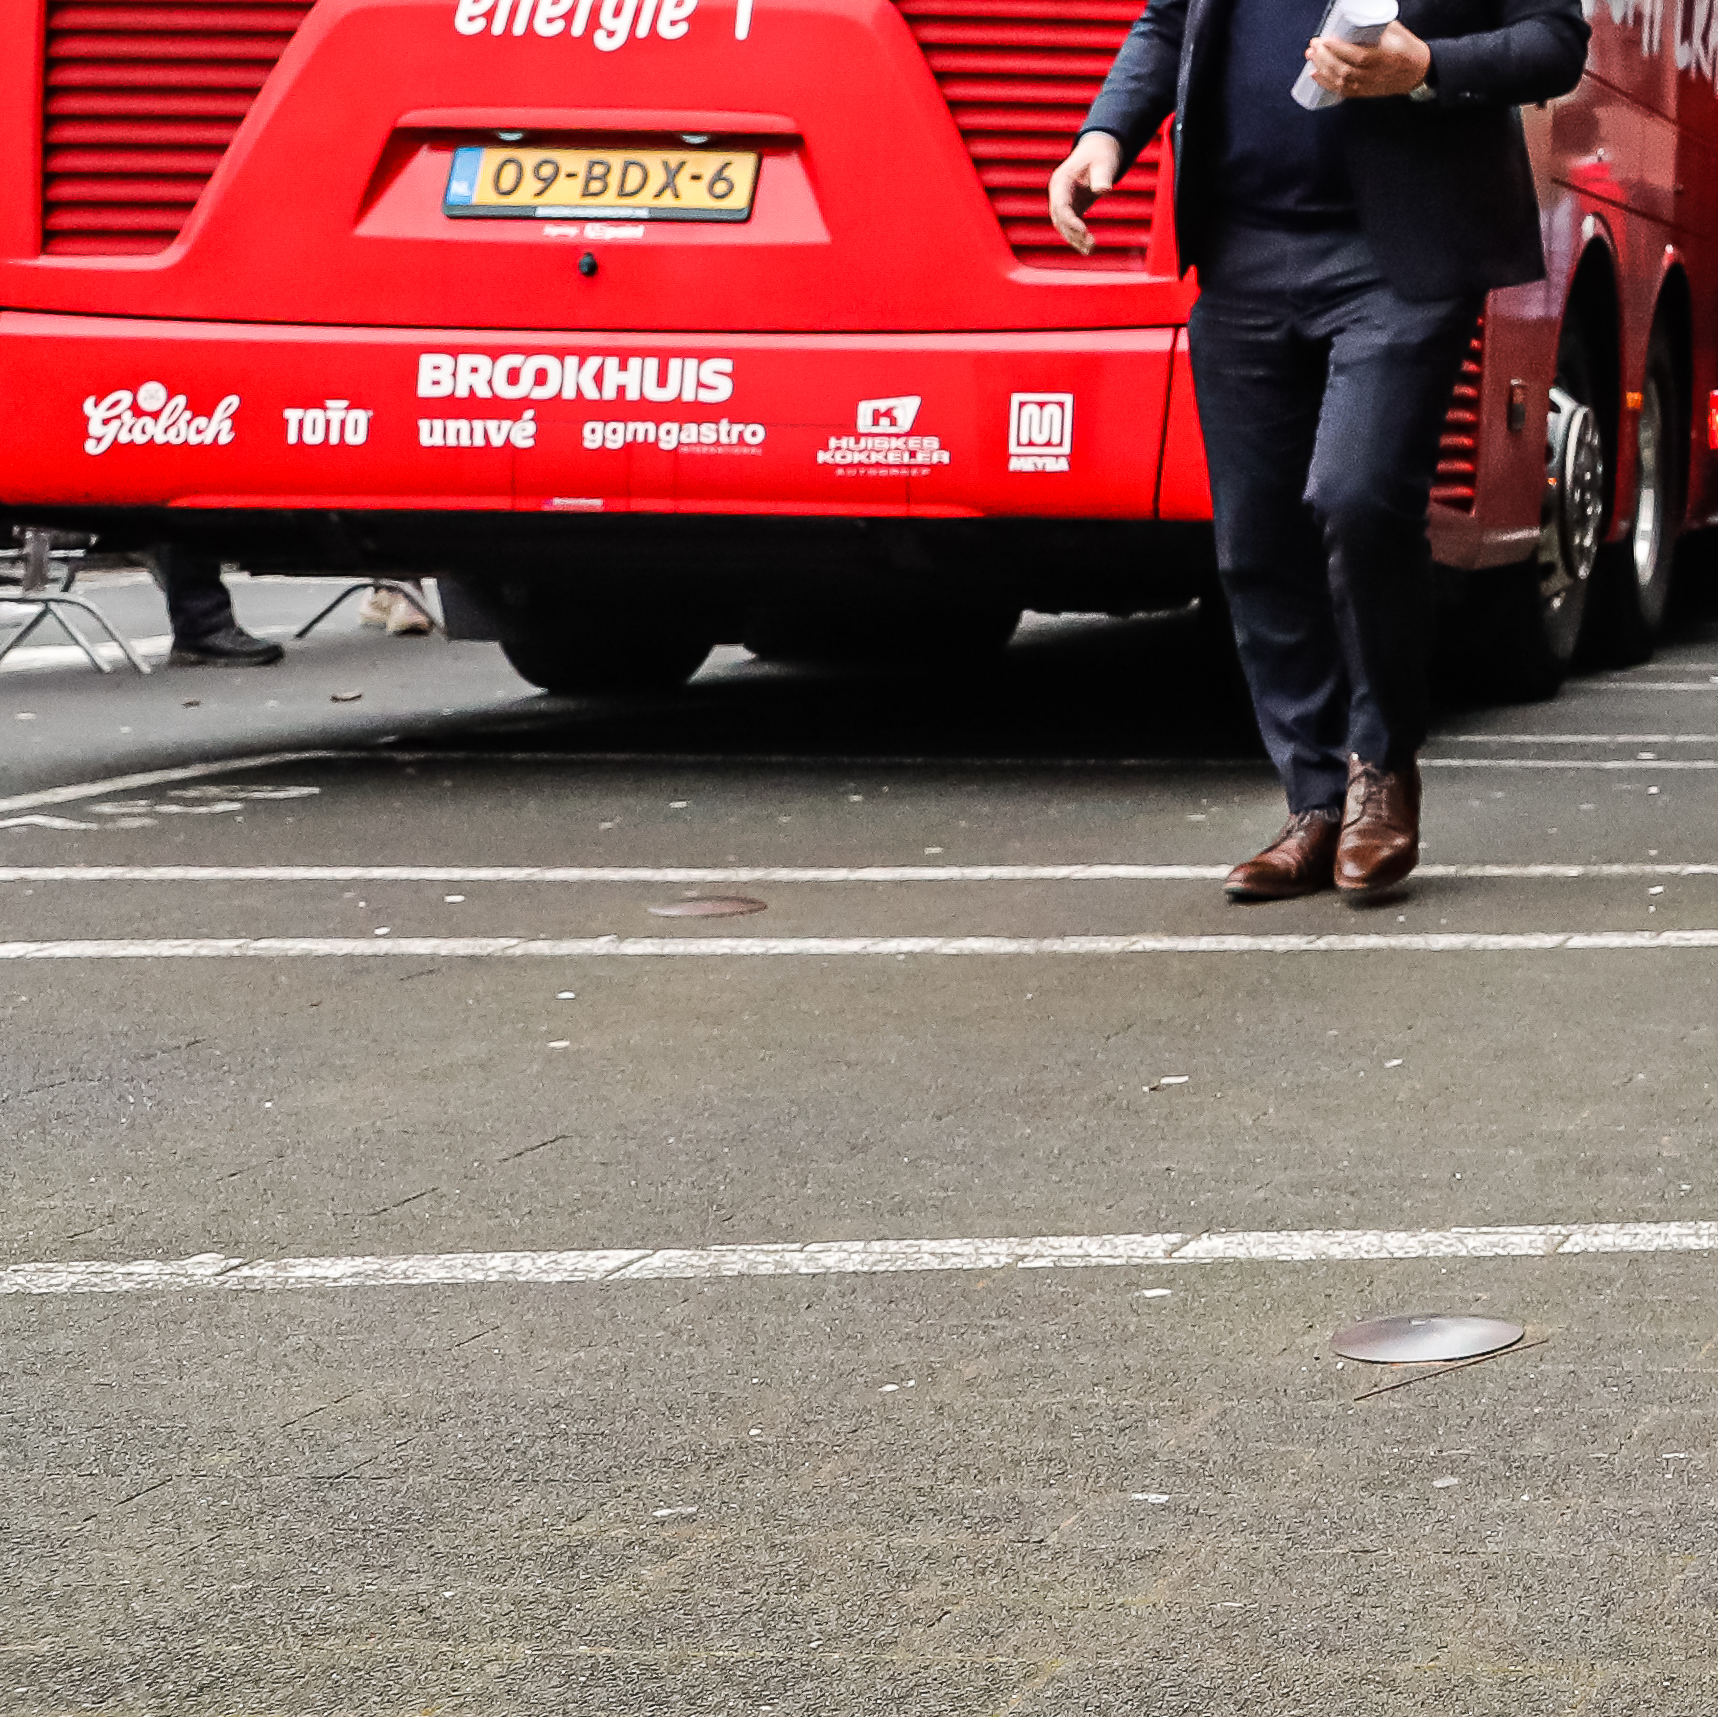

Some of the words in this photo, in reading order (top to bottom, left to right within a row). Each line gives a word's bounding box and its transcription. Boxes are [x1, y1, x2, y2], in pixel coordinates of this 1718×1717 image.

[492, 157, 736, 201] 09-BDX-6
[417, 354, 734, 403] BROOKHUIS
[83, 389, 241, 456] Grolsch
[283, 400, 370, 446] TOTO
[418, 409, 537, 449] univé
[582, 418, 766, 451] ggmgastro
